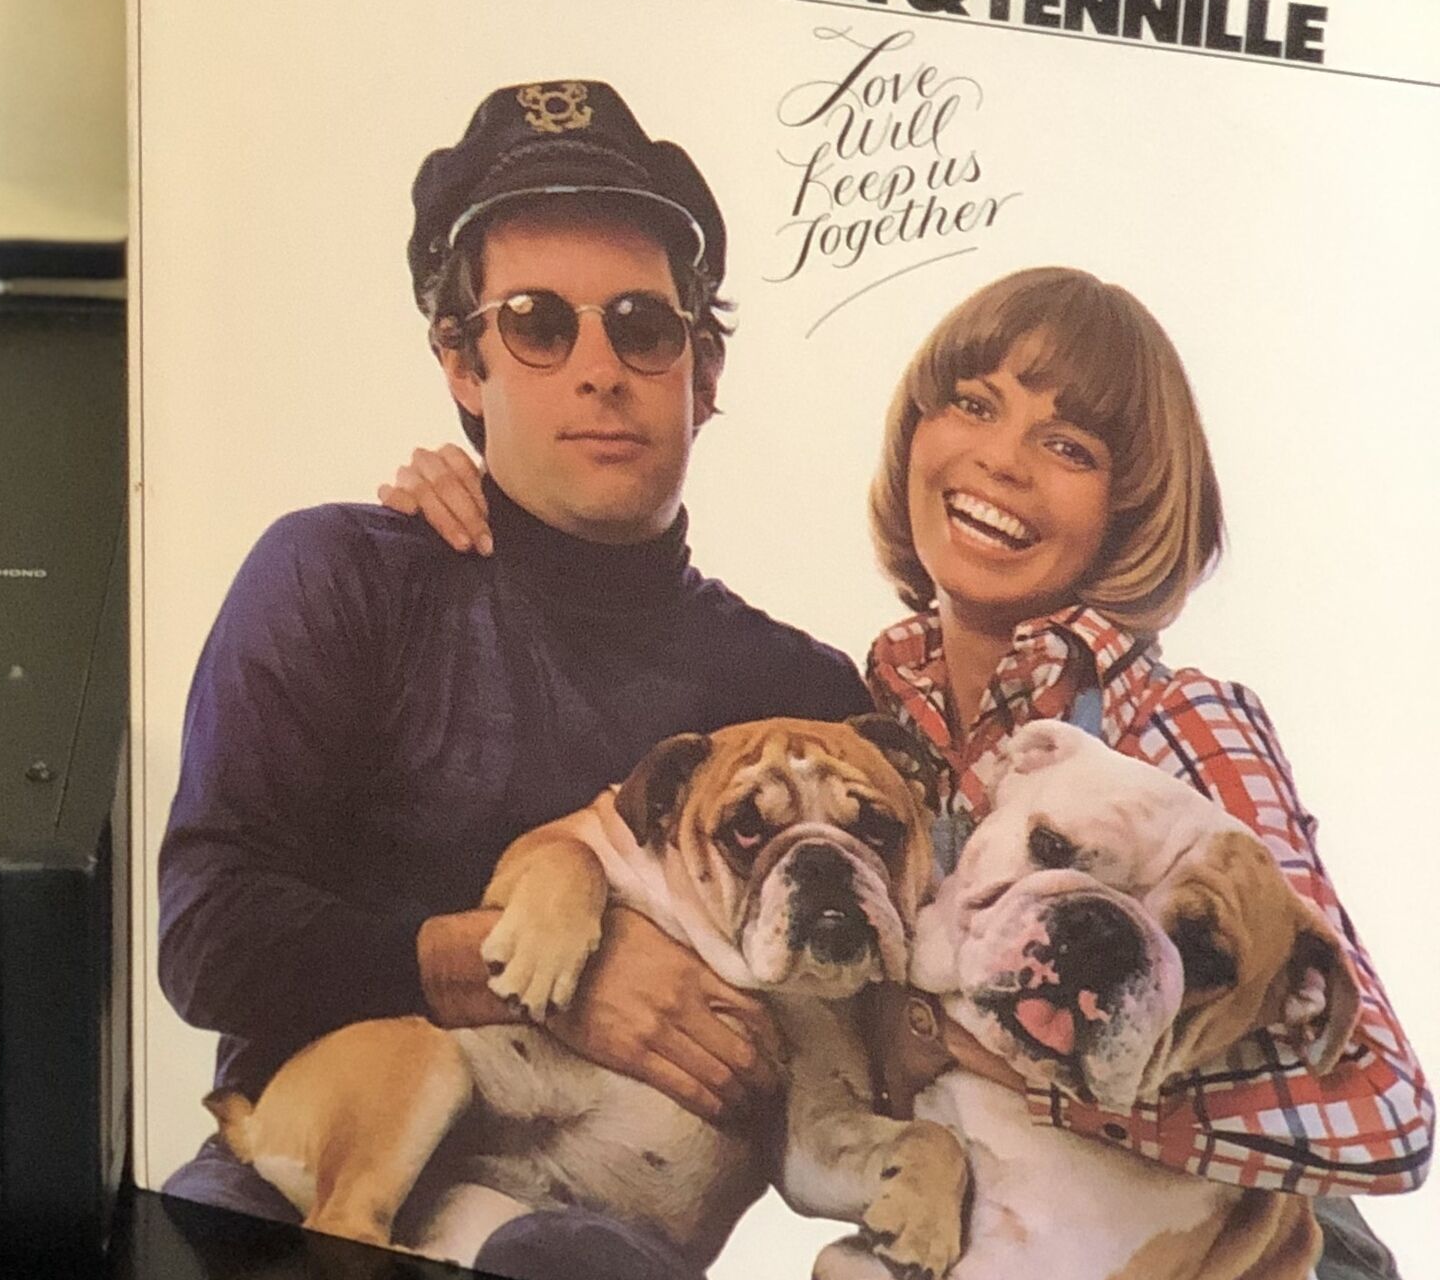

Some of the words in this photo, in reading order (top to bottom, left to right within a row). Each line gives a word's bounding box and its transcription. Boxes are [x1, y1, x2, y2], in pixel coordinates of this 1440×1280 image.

[777, 26, 984, 127] Love
[825, 94, 961, 160] Will
[776, 141, 916, 217] Keep
[927, 150, 982, 191] us
[760, 191, 1024, 283] Together
